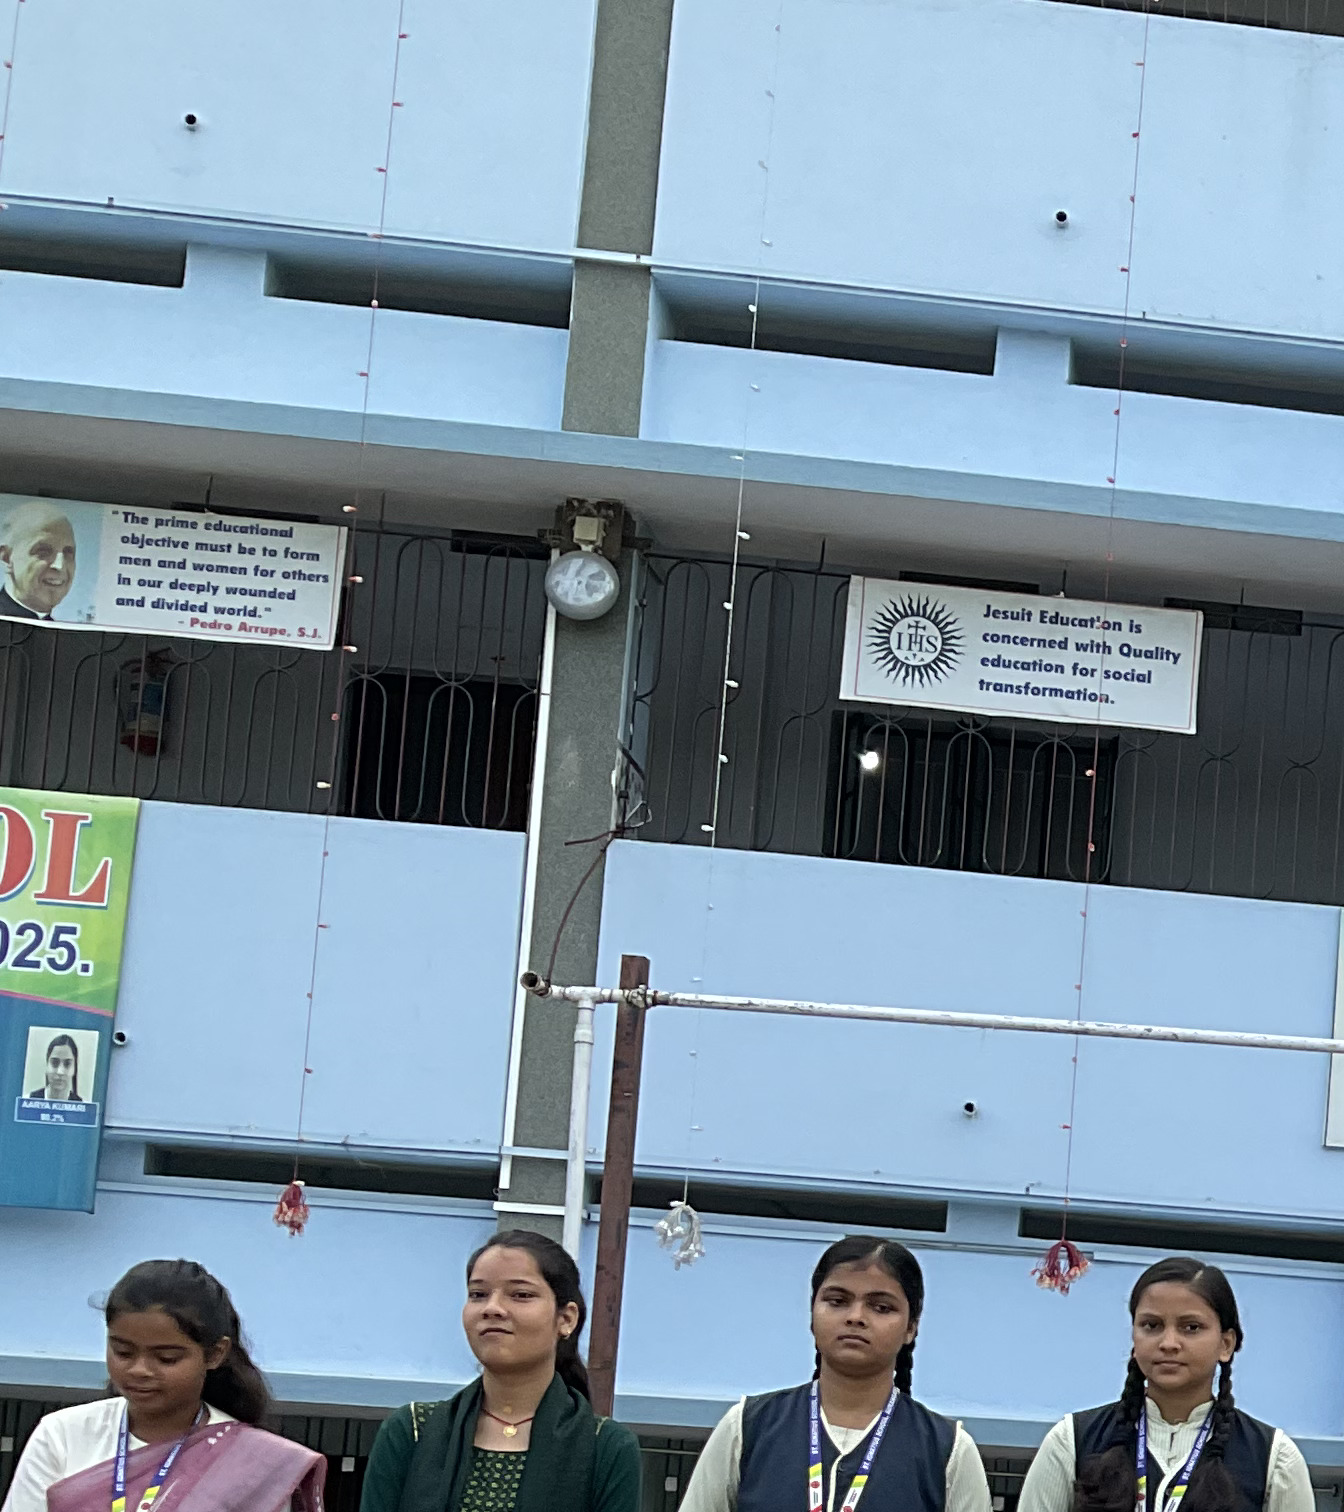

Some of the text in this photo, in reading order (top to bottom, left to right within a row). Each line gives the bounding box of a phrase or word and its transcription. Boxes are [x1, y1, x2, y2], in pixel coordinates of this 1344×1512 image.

[154, 514, 198, 531] prime
[204, 519, 294, 538] educational
[121, 533, 320, 562] objective must be to form
[119, 555, 329, 584] men and women for others
[117, 573, 296, 601] in our deeply wounded
[115, 595, 145, 608] and
[151, 597, 208, 614] divided
[190, 617, 232, 632] Pedro
[297, 626, 322, 639] S.J.
[983, 604, 1142, 634] Jesuit Education is
[896, 630, 939, 654] IHS
[982, 631, 1182, 665] concerned with Quality
[980, 655, 1152, 685] education for social
[978, 679, 1115, 705] transformation.
